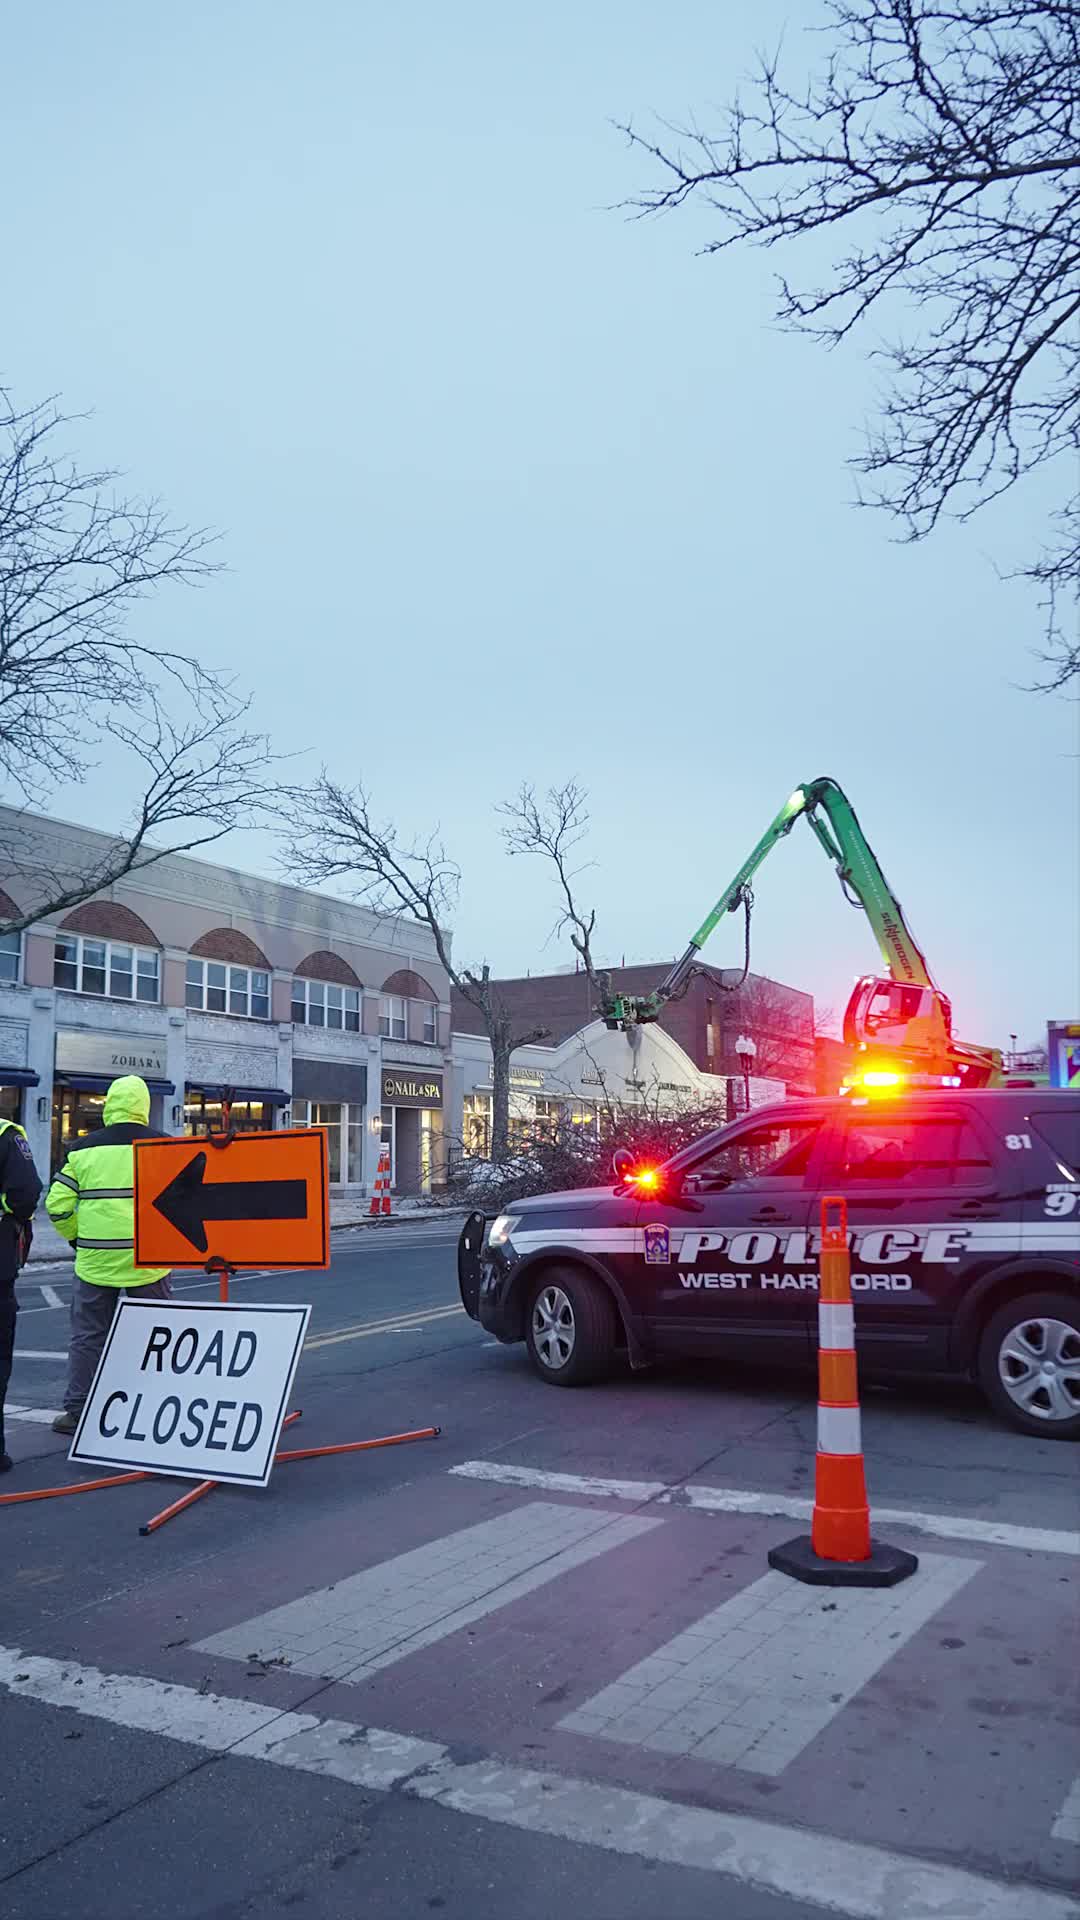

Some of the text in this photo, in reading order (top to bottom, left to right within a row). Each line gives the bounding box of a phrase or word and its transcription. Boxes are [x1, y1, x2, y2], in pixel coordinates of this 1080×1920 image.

[111, 1054, 161, 1069] ZOHARA
[395, 1081, 418, 1096] NAIL
[424, 1084, 440, 1098] SPA
[1005, 1134, 1032, 1149] 81
[1043, 1193, 1080, 1216] 9
[679, 1273, 912, 1290] WEST HARORD
[140, 1326, 257, 1378] ROAD
[99, 1390, 263, 1453] CLOSED
